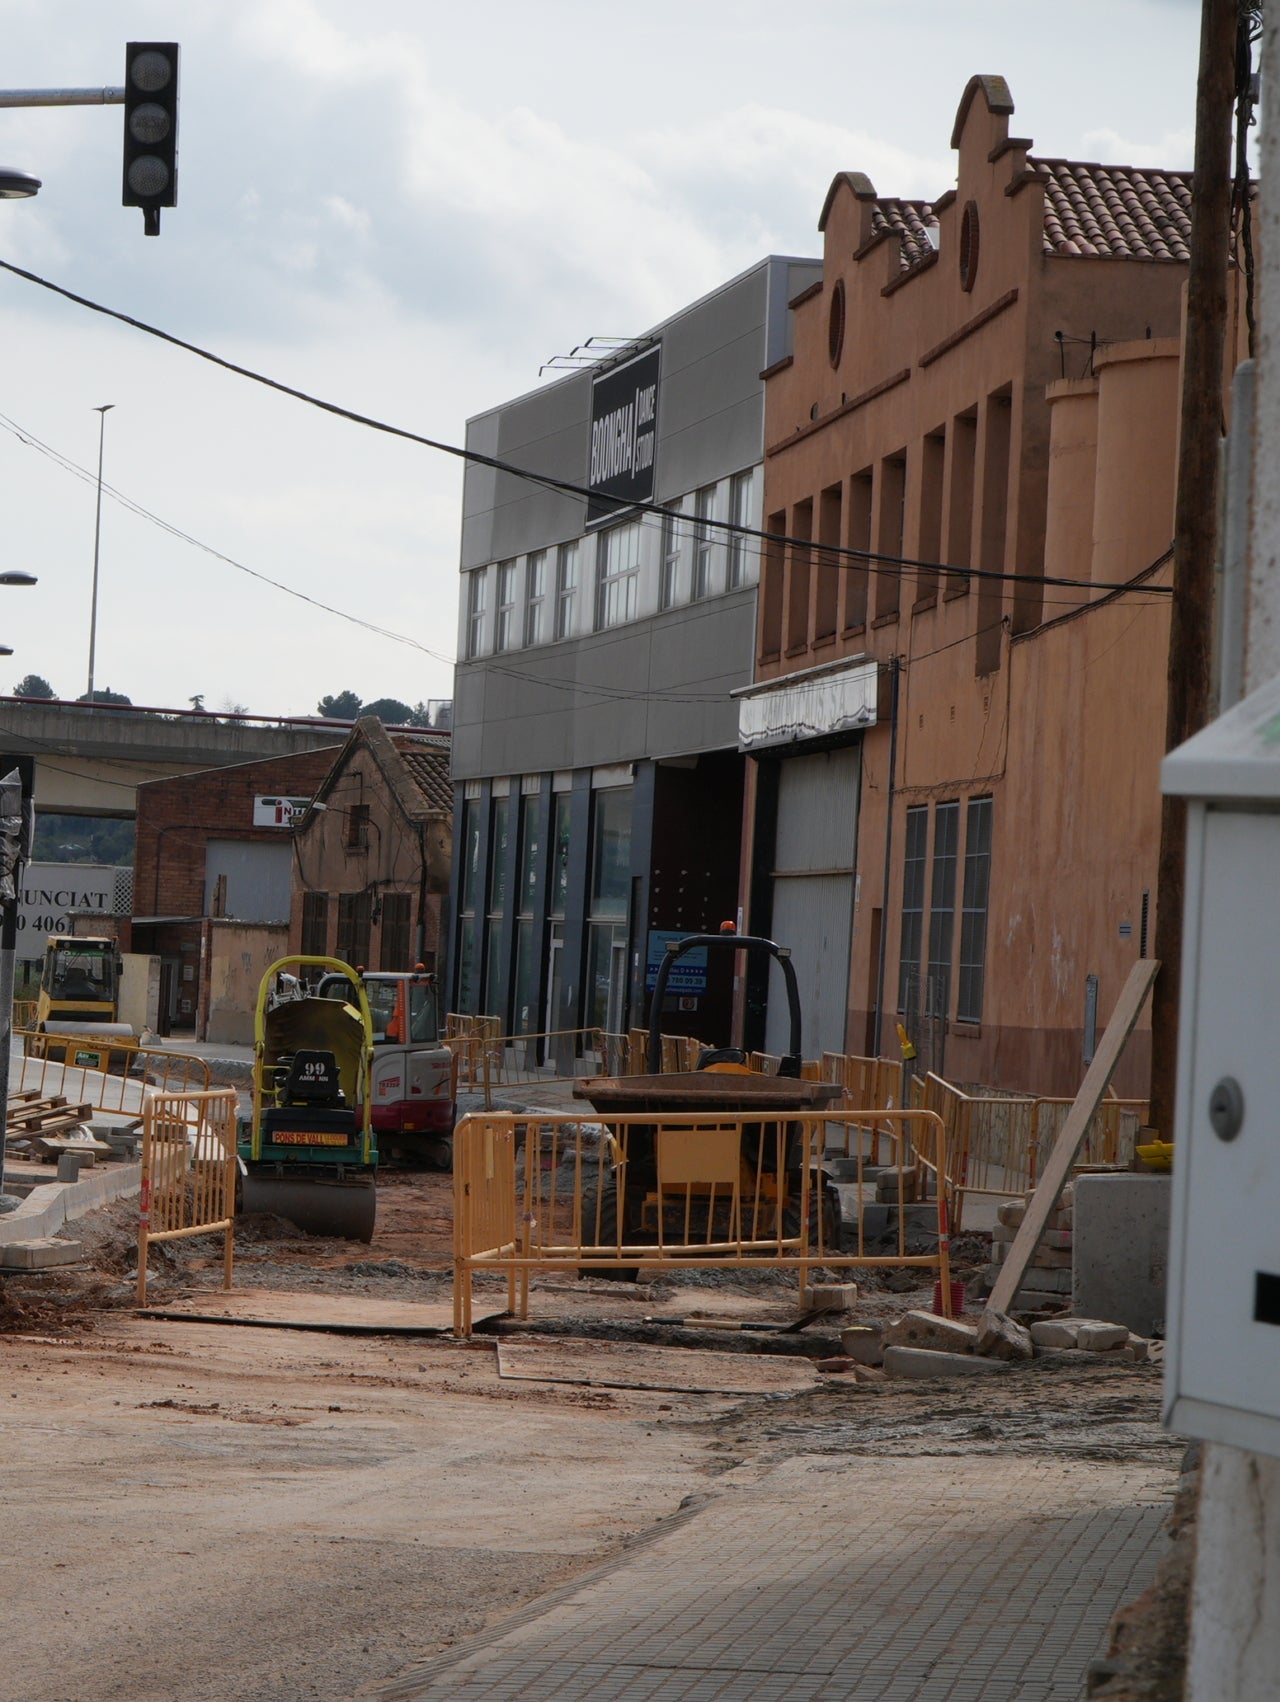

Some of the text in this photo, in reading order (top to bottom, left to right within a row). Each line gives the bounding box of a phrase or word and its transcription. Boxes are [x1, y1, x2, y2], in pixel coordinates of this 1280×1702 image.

[590, 402, 634, 486] BOONGHA
[636, 430, 654, 472] STUDIO
[32, 915, 66, 933] 406
[305, 1062, 325, 1075] 99
[275, 1133, 295, 1144] PONS
[296, 1134, 306, 1144] DE
[307, 1134, 324, 1145] VALL
